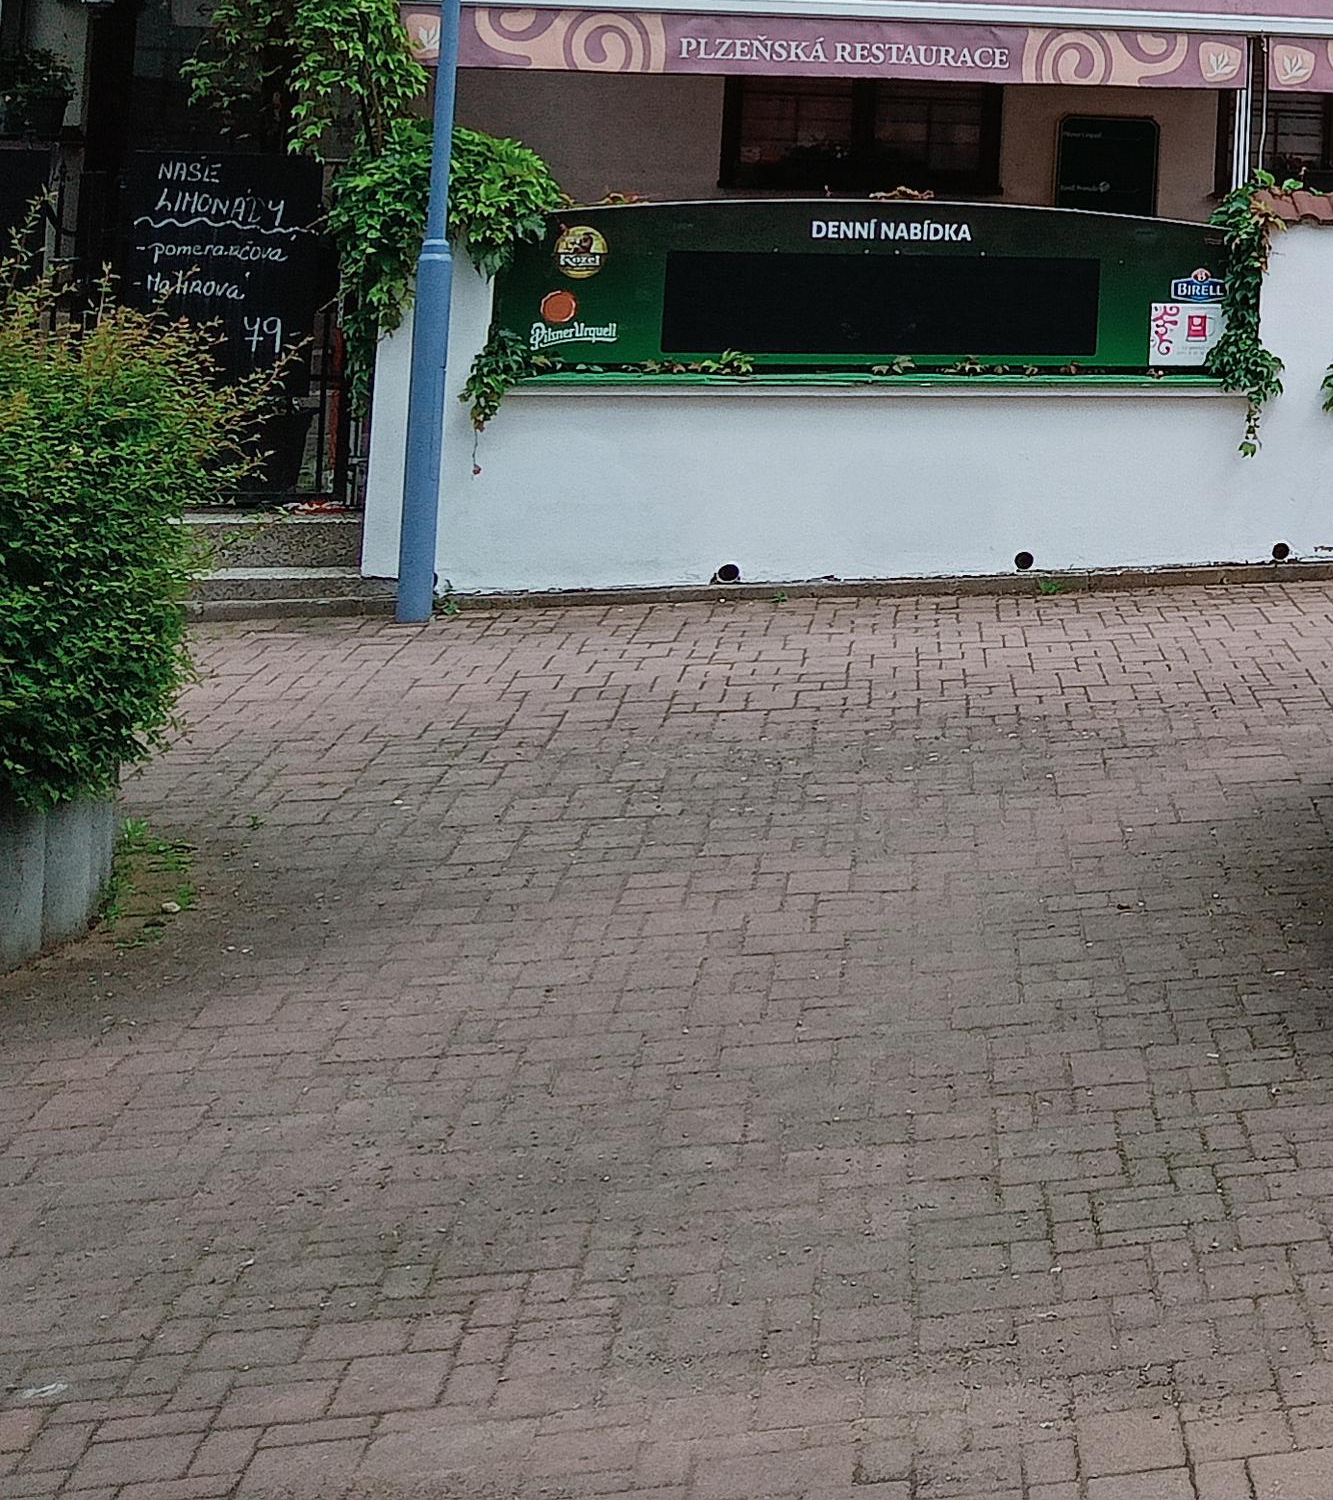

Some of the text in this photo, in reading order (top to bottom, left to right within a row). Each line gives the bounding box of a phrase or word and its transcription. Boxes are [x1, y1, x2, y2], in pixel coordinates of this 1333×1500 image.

[679, 35, 1010, 69] PLZEŇSKÁ RESTAURACE
[812, 218, 972, 241] DENNÍ NABÍDKA
[1177, 283, 1224, 296] BIRELL
[530, 321, 617, 350] Pilsner Urquell
